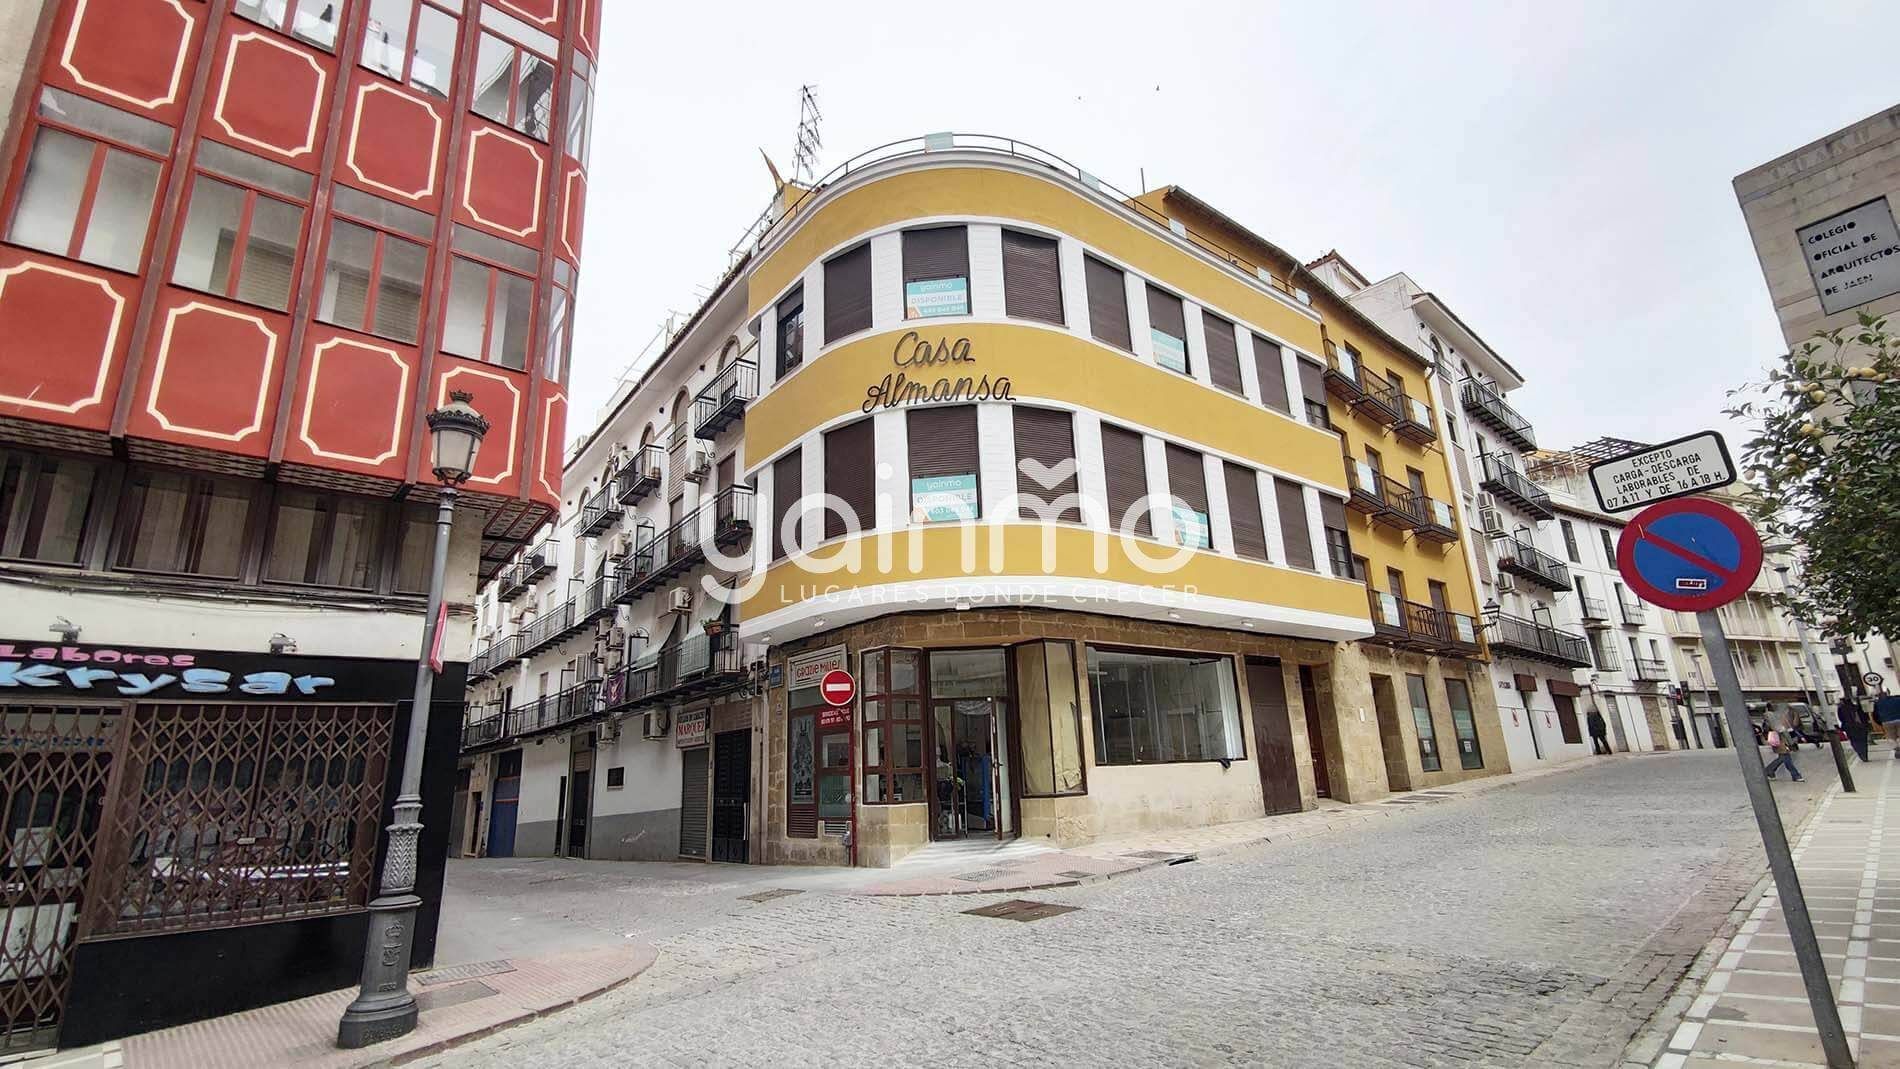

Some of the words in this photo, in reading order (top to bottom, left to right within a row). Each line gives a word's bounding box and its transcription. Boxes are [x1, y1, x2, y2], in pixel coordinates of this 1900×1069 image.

[1808, 222, 1856, 244] COLEGIO
[1814, 241, 1857, 260] OFICIAL
[1862, 233, 1878, 244] DE
[1821, 245, 1900, 279] ARQUITECTOS
[1825, 286, 1839, 296] DE
[893, 331, 976, 368] Casa
[862, 373, 1017, 413] Almansa
[1632, 449, 1673, 468] EXCEPTO
[1607, 497, 1618, 508] 07
[1622, 496, 1630, 505] A
[1630, 492, 1640, 502] 11
[1645, 489, 1652, 498] Y
[1659, 484, 1673, 495] DE
[1677, 480, 1688, 490] 16
[1691, 479, 1699, 488] A
[1700, 473, 1711, 484] 18
[1713, 471, 1726, 481] H.
[1616, 472, 1676, 494] LABORABLES
[1687, 465, 1700, 477] DE
[0, 644, 195, 667] Labores
